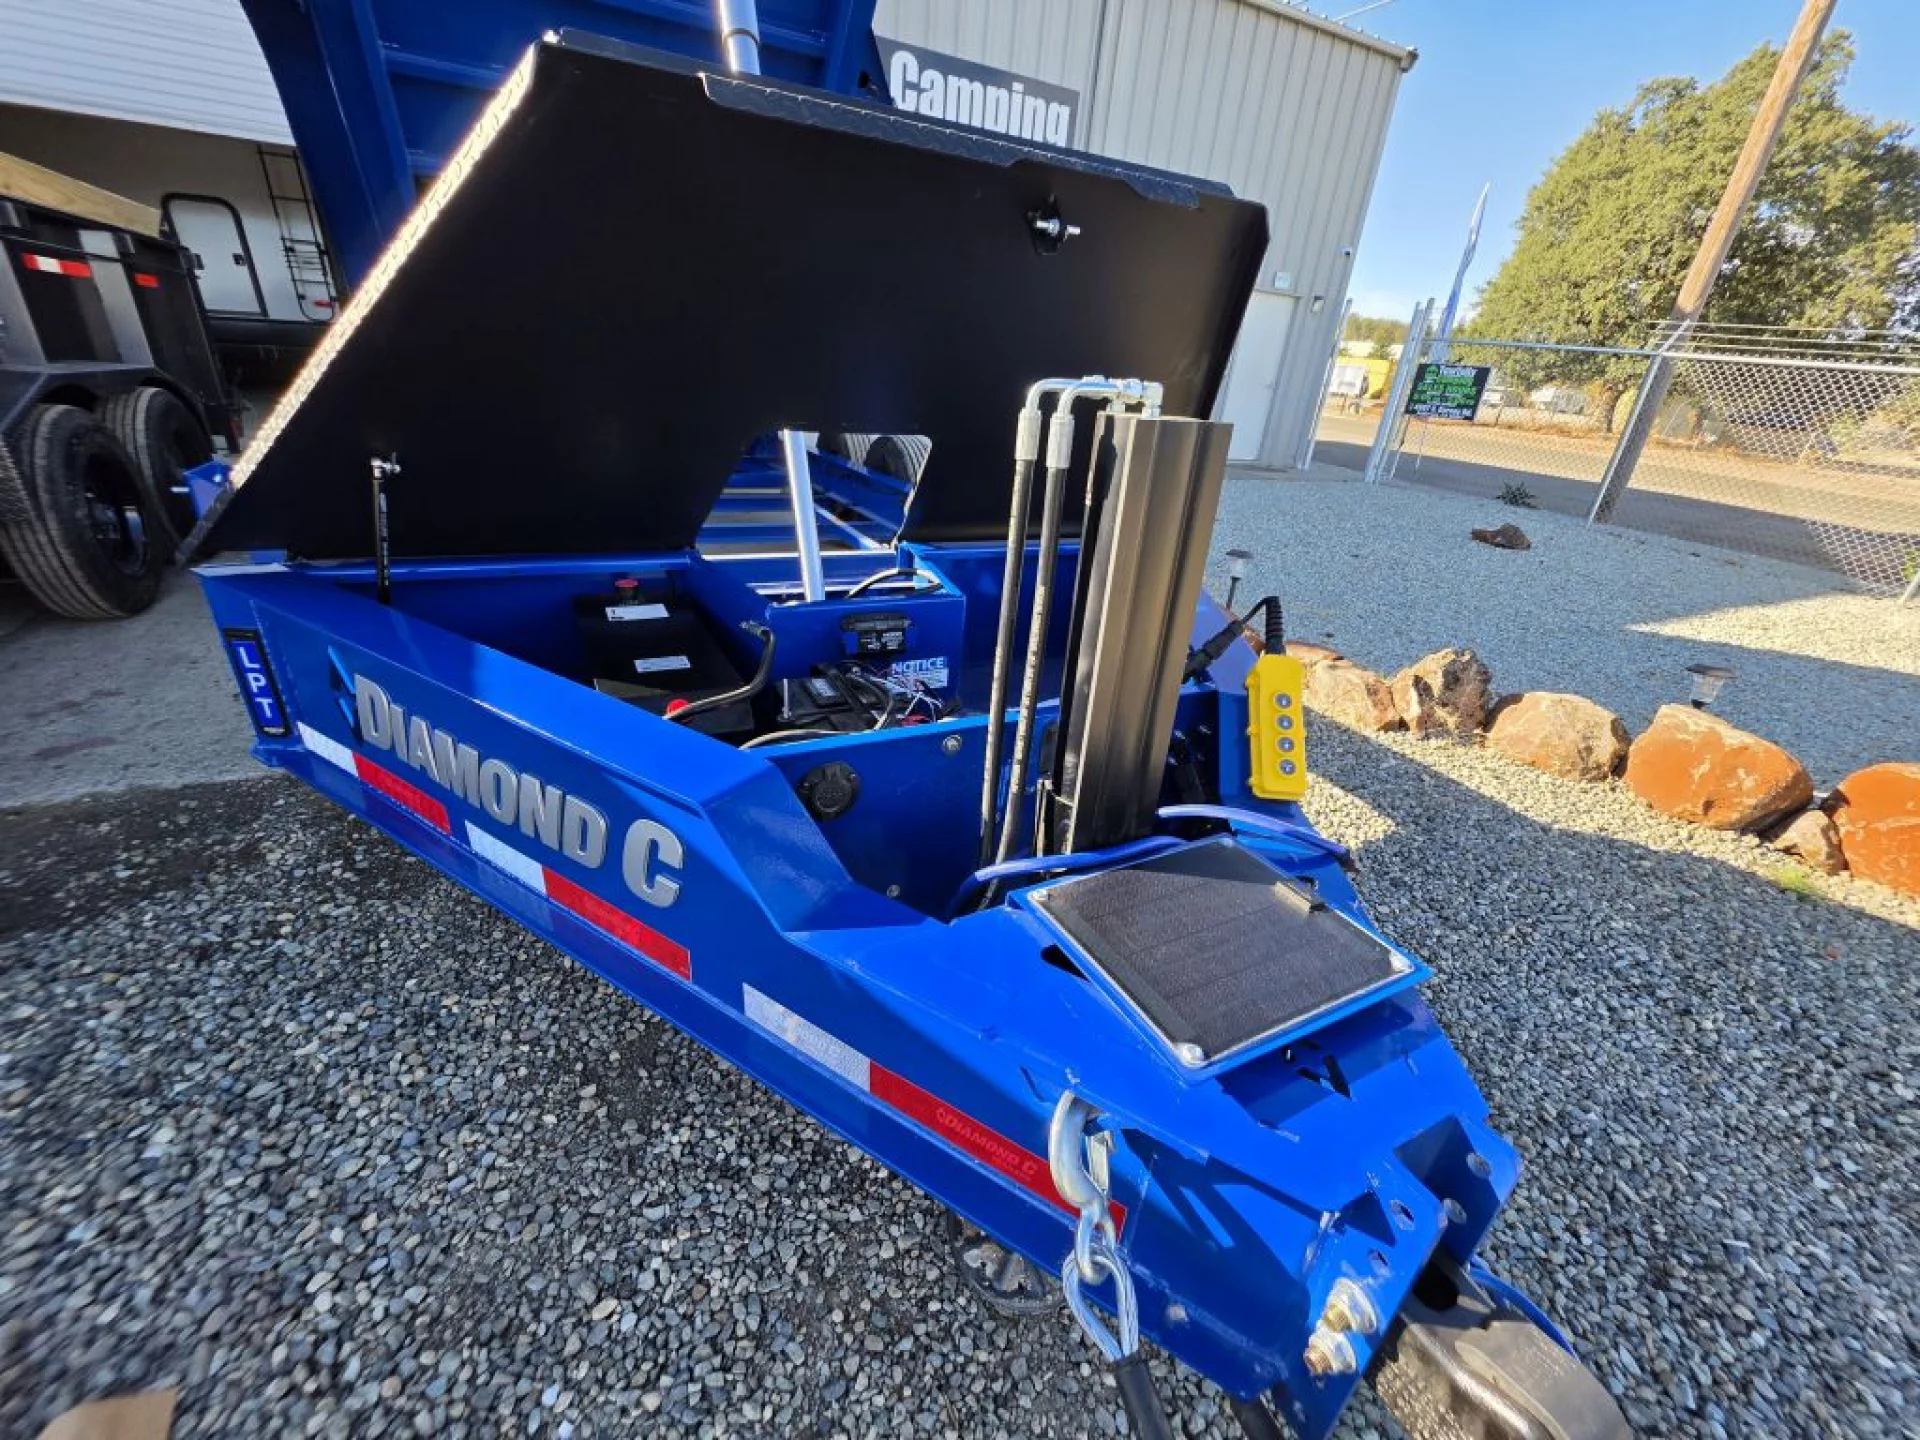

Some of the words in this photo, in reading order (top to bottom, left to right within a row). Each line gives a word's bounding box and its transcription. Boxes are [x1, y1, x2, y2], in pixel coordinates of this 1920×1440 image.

[890, 50, 1070, 147] Camping
[237, 646, 273, 719] LPT
[891, 657, 944, 674] NOTICE
[355, 674, 607, 869] DIAMOND
[622, 818, 684, 908] C
